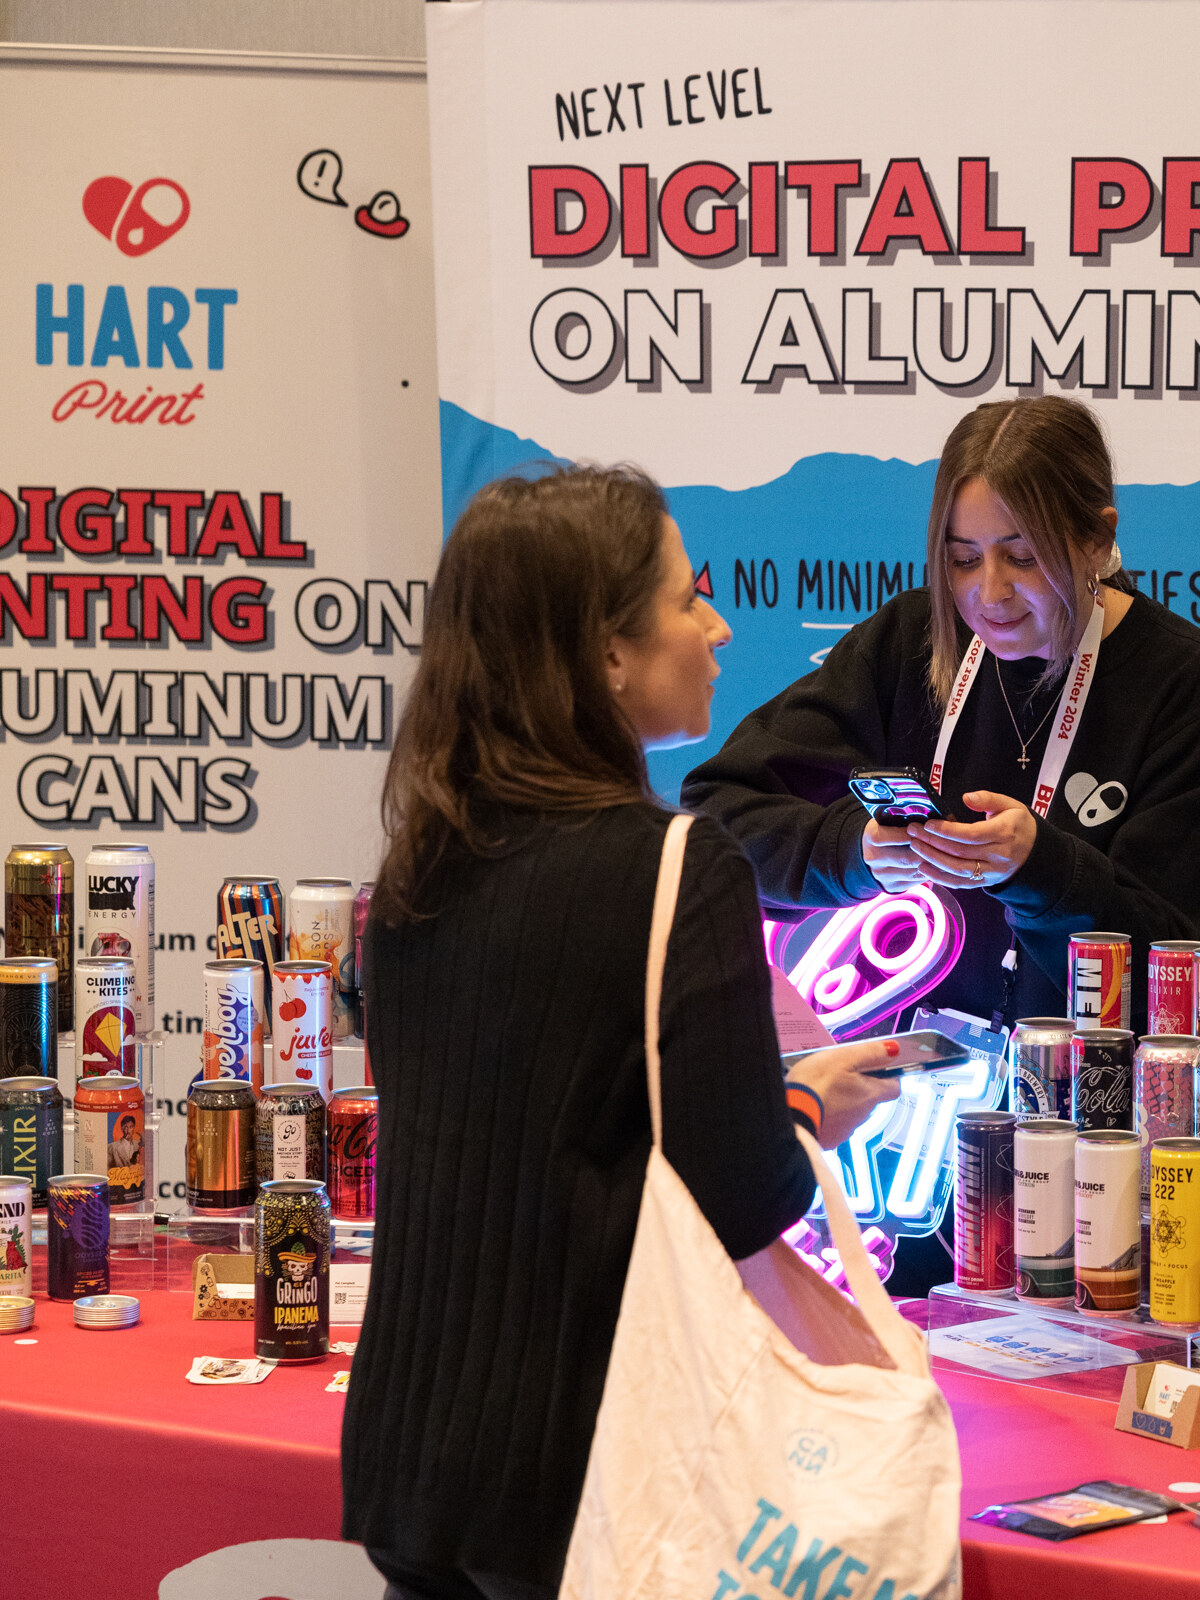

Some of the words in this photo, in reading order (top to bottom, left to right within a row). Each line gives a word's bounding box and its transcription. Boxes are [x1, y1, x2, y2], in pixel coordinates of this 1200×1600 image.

[556, 81, 646, 142] NEXT
[663, 67, 773, 127] LEVEL
[527, 156, 1028, 262] DIGITAL
[35, 282, 239, 371] HART
[529, 286, 707, 388] ON
[51, 379, 205, 426] Print
[734, 557, 778, 611] NO
[947, 667, 973, 718] Winter
[1069, 652, 1093, 705] Winter
[1057, 704, 1078, 741] 2024
[17, 754, 252, 827] CANS
[88, 875, 140, 893] LUCKY
[88, 911, 137, 919] ENERGY
[86, 975, 135, 987] CLIMBING
[98, 987, 128, 997] KITES
[1155, 1183, 1176, 1200] 222
[274, 1305, 319, 1325] IPANEMA
